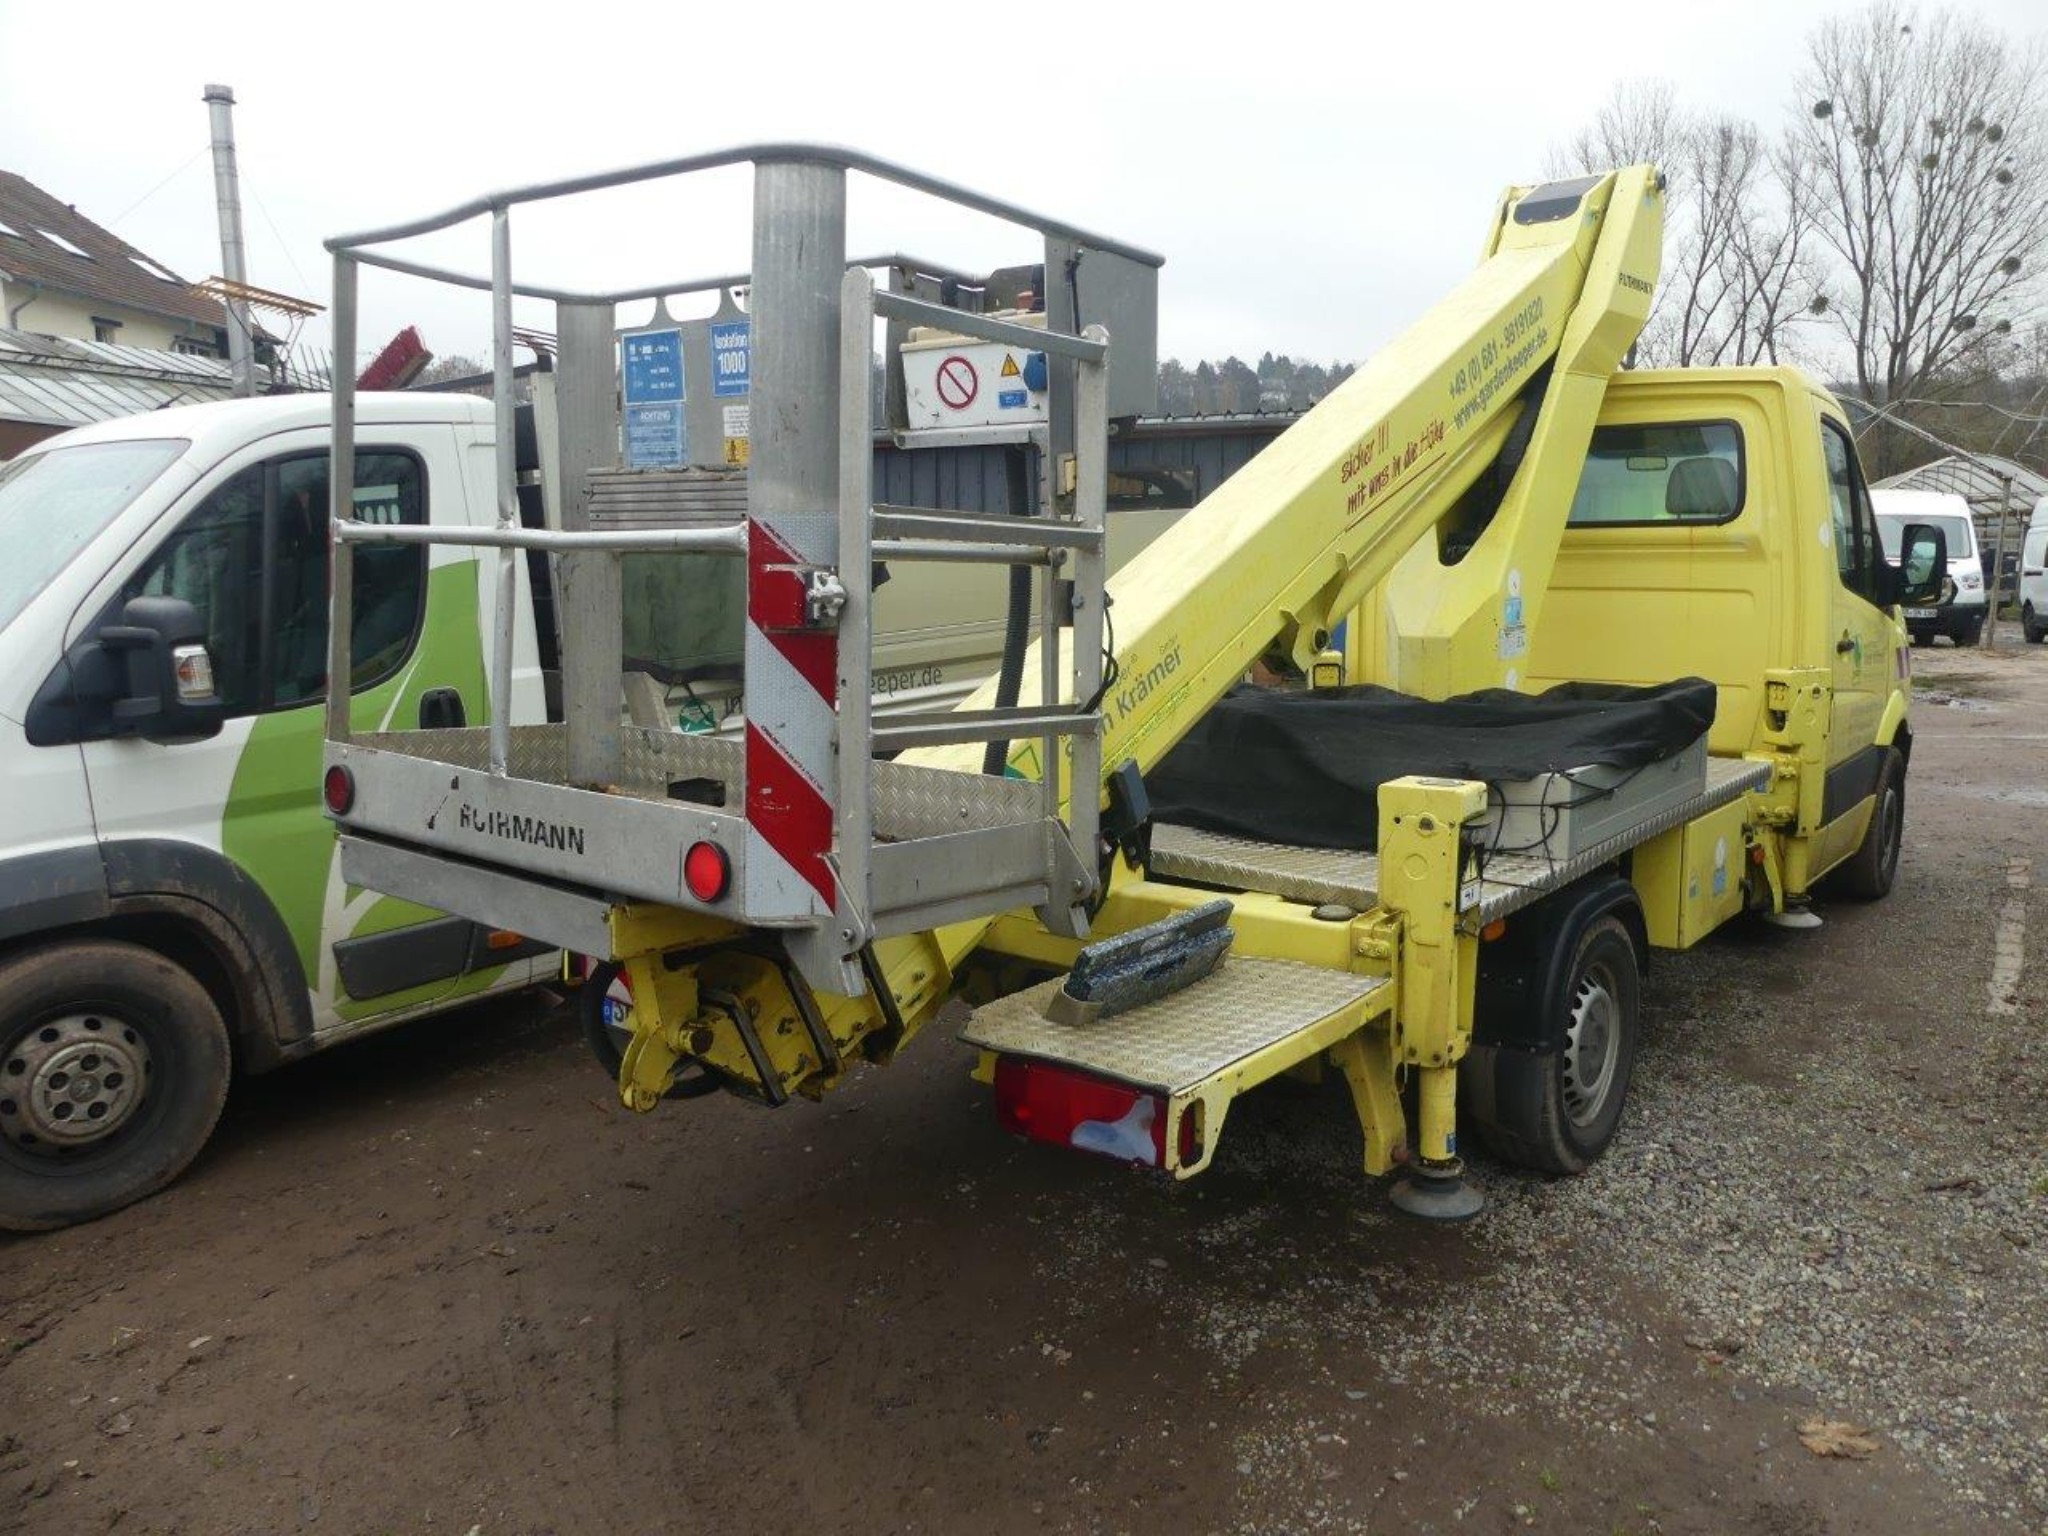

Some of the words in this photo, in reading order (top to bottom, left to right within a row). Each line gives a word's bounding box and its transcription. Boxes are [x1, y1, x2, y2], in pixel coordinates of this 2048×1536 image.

[714, 332, 748, 350] Isolation
[717, 351, 746, 375] 1000
[1449, 370, 1467, 401] +49
[1467, 358, 1482, 390] (0)
[1480, 338, 1499, 371] 681
[1347, 481, 1367, 515] mit
[1368, 465, 1390, 498] uns
[1392, 455, 1401, 479] in
[1403, 440, 1418, 471] die
[1116, 644, 1182, 721] Krämer
